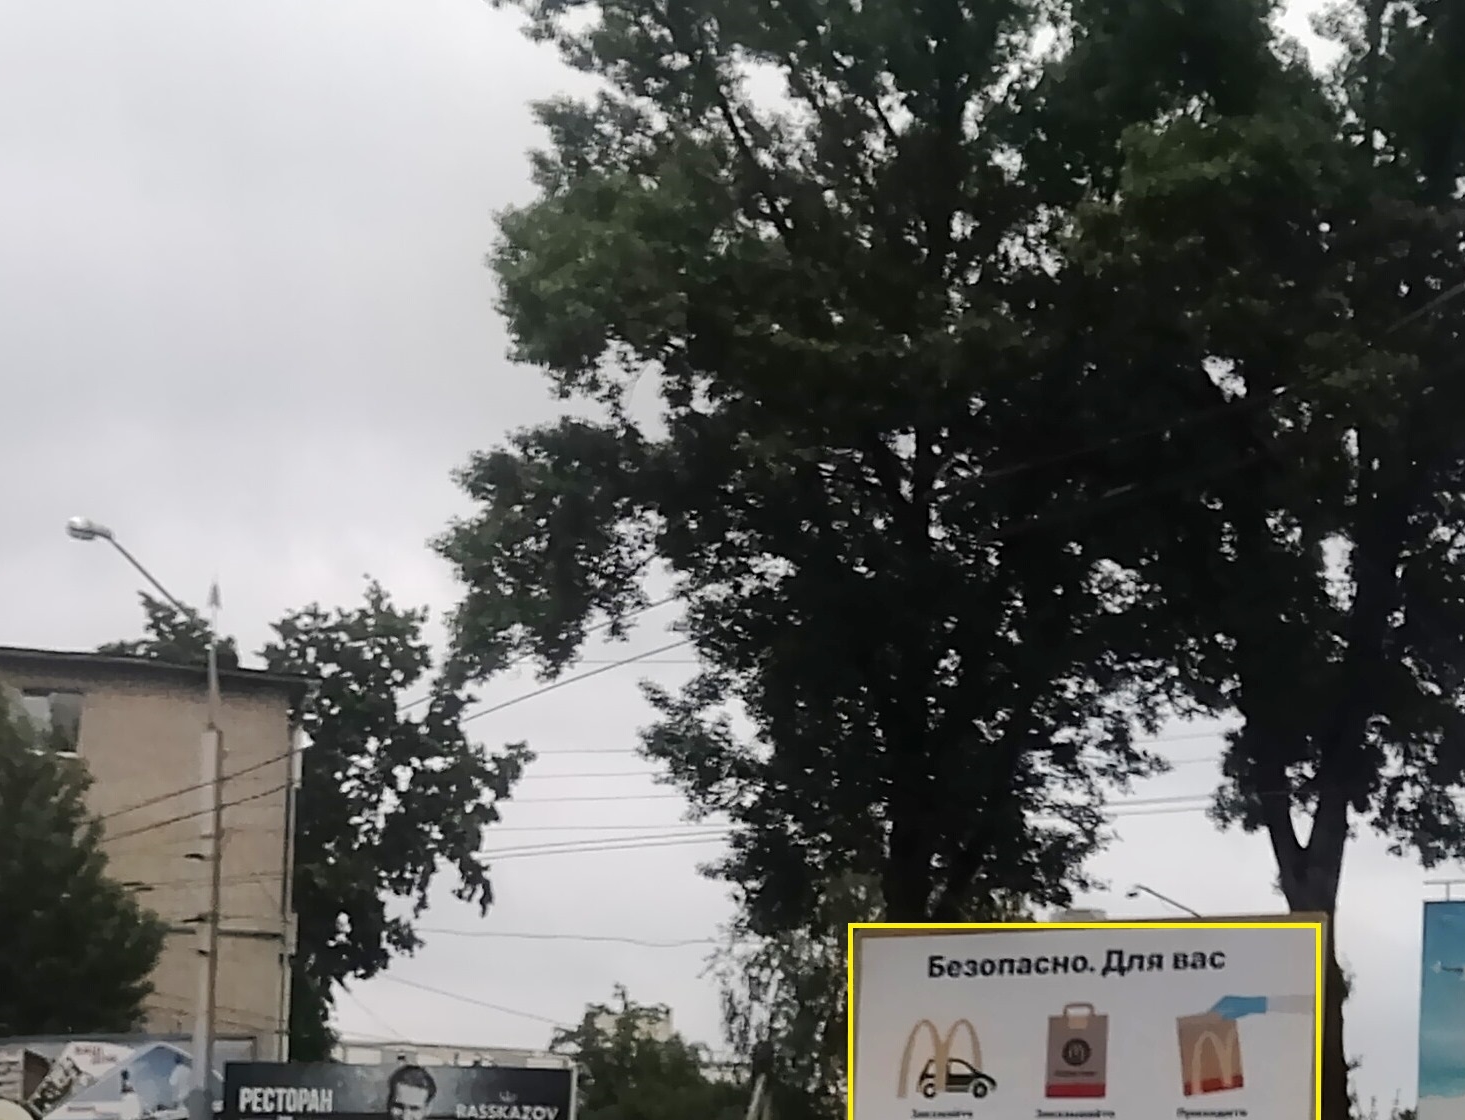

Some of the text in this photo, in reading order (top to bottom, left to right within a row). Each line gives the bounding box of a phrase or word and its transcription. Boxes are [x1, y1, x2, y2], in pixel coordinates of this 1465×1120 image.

[927, 949, 1226, 979] Безопасно. Для вас
[239, 1086, 333, 1113] РЕСТОРАН
